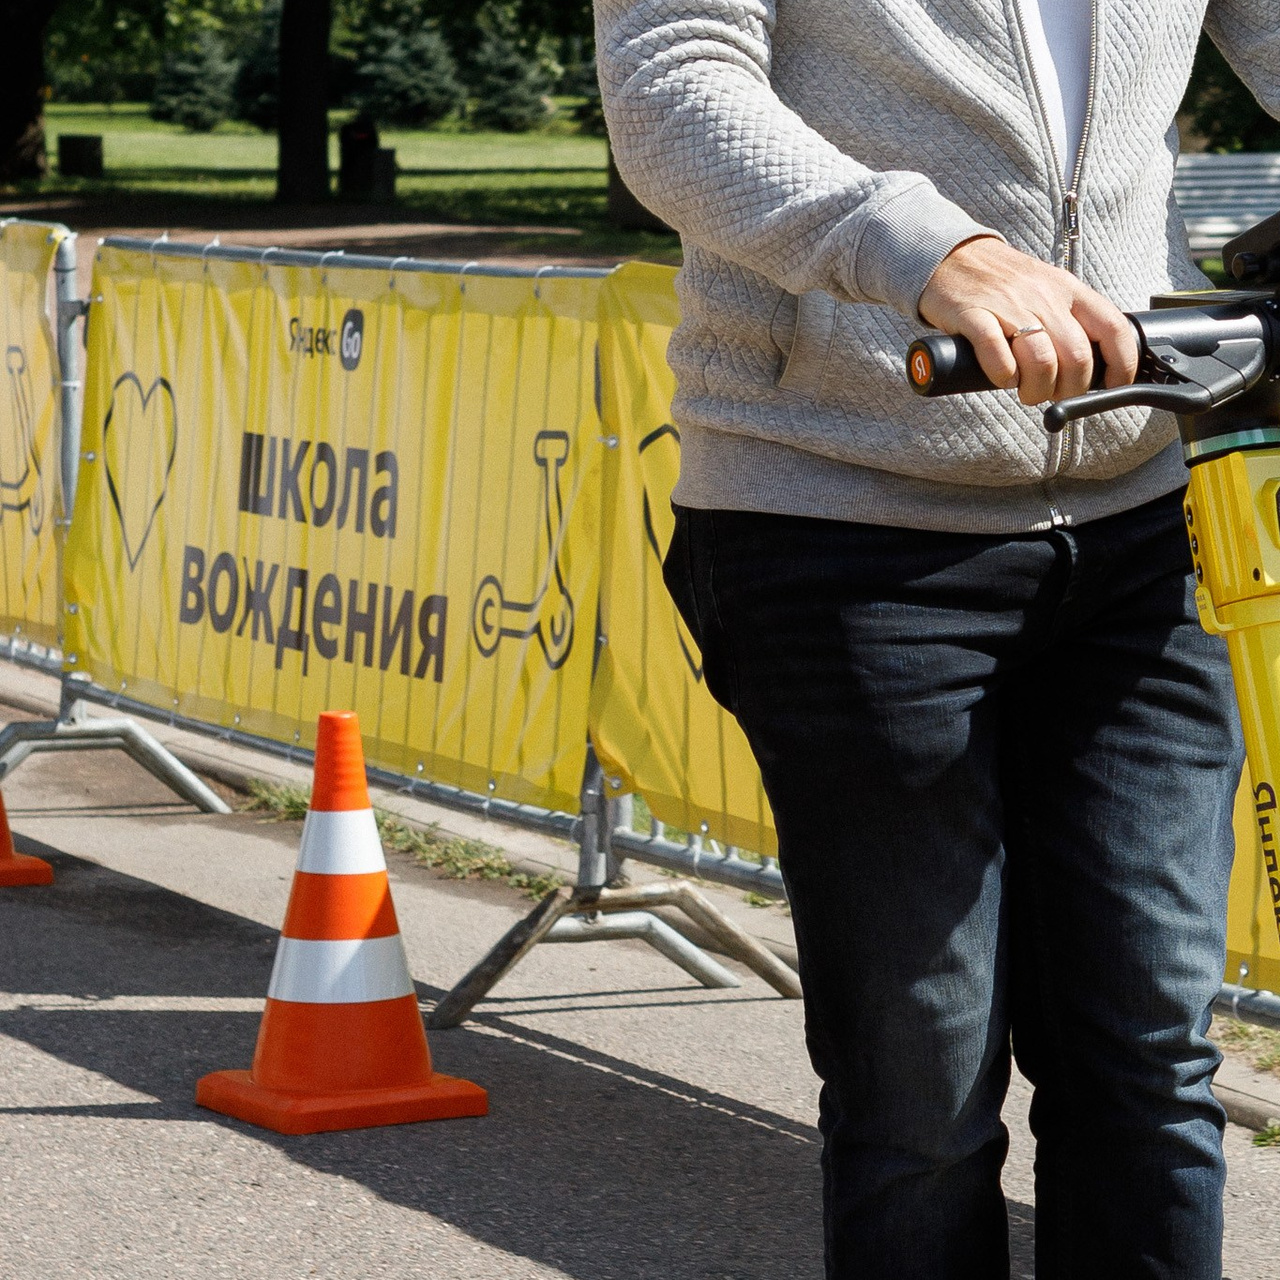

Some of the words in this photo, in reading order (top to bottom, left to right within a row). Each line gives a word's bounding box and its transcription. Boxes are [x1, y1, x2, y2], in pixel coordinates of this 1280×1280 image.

[342, 320, 361, 359] Go
[238, 431, 398, 540] школа
[179, 544, 448, 683] вождения
